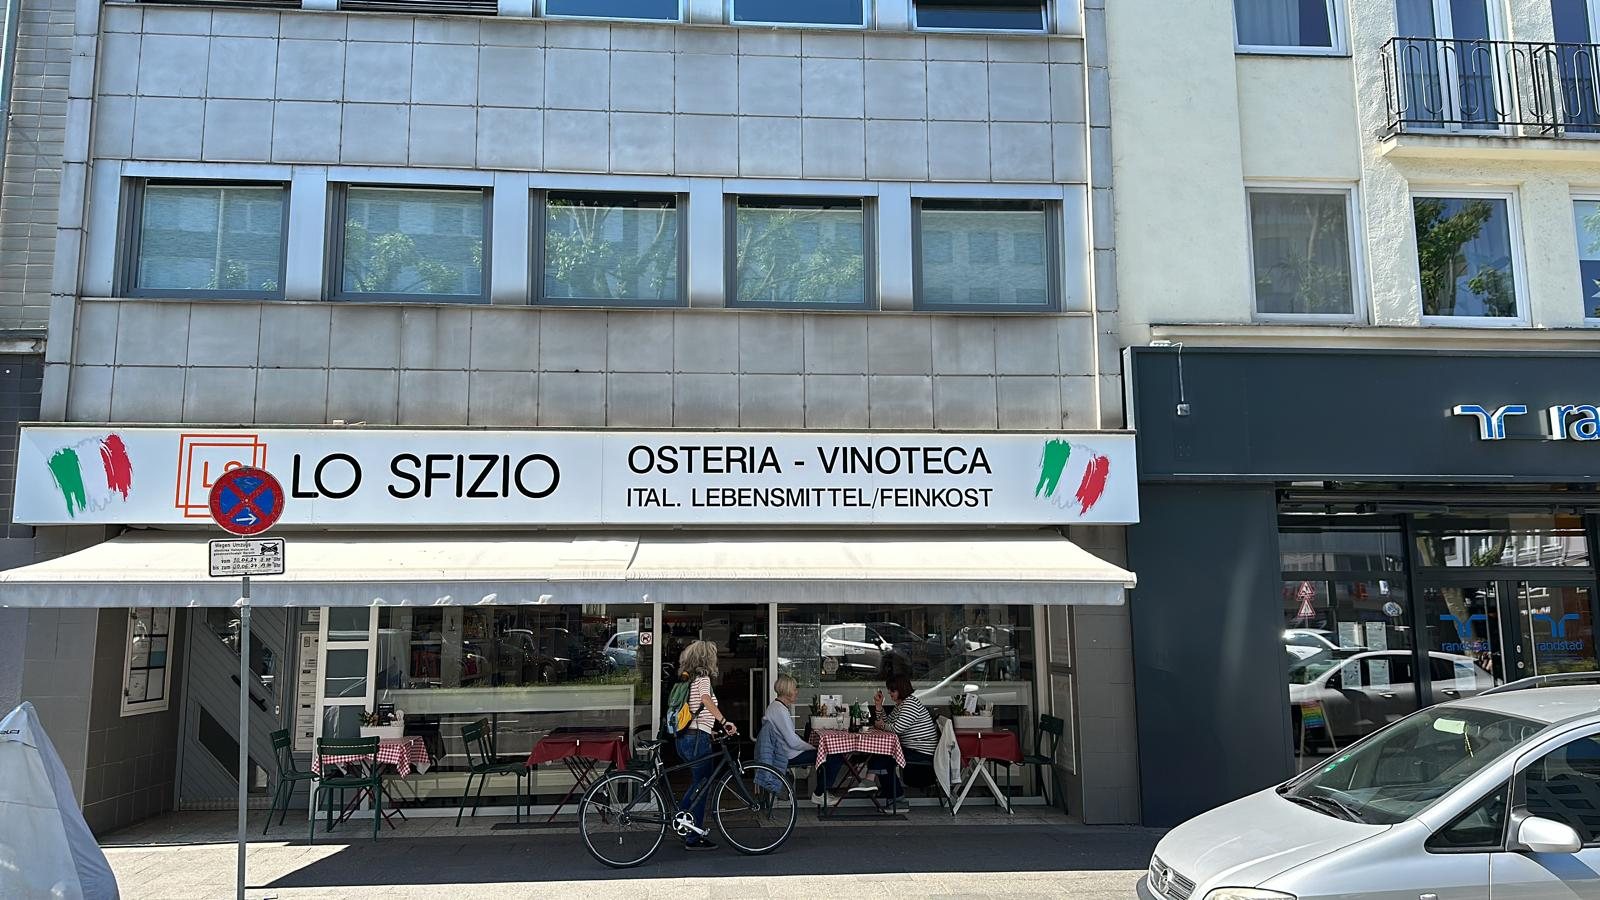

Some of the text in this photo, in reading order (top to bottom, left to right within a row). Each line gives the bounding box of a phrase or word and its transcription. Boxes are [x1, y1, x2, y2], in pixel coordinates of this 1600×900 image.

[1549, 404, 1600, 441] ra
[627, 445, 782, 474] OSTERIA
[816, 446, 992, 475] VINOTECA
[291, 453, 561, 499] LO SFIZIO
[627, 487, 993, 510] ITAL. LEBENSMITTEL/FEINKOST
[1536, 639, 1584, 652] randstad
